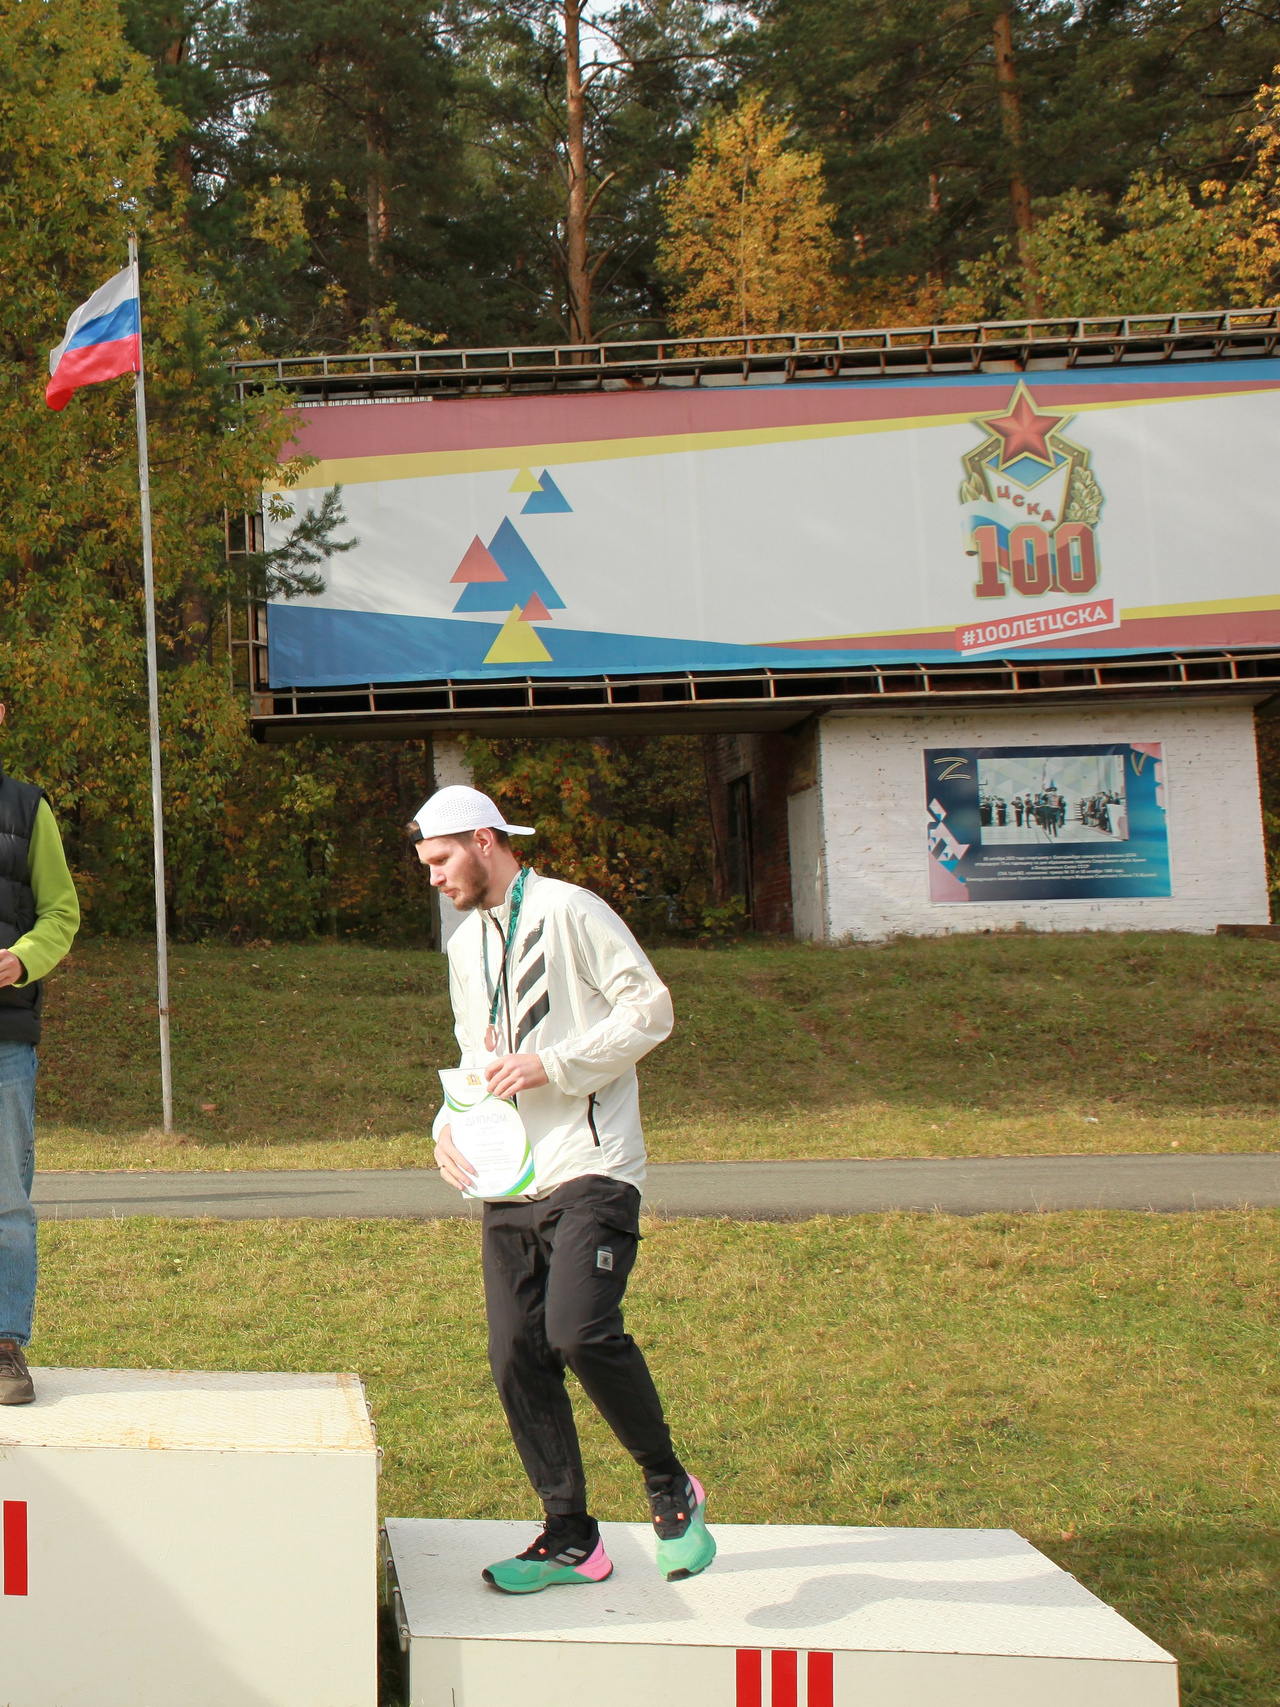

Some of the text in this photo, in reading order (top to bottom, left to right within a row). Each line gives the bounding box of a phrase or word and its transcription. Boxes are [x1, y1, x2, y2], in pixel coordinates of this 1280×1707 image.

[996, 485, 1055, 522] ЦСКА
[973, 522, 1098, 599] 100
[962, 605, 1108, 647] #100ЛЕТЦСКА
[933, 756, 971, 781] Z
[1131, 751, 1148, 776] V
